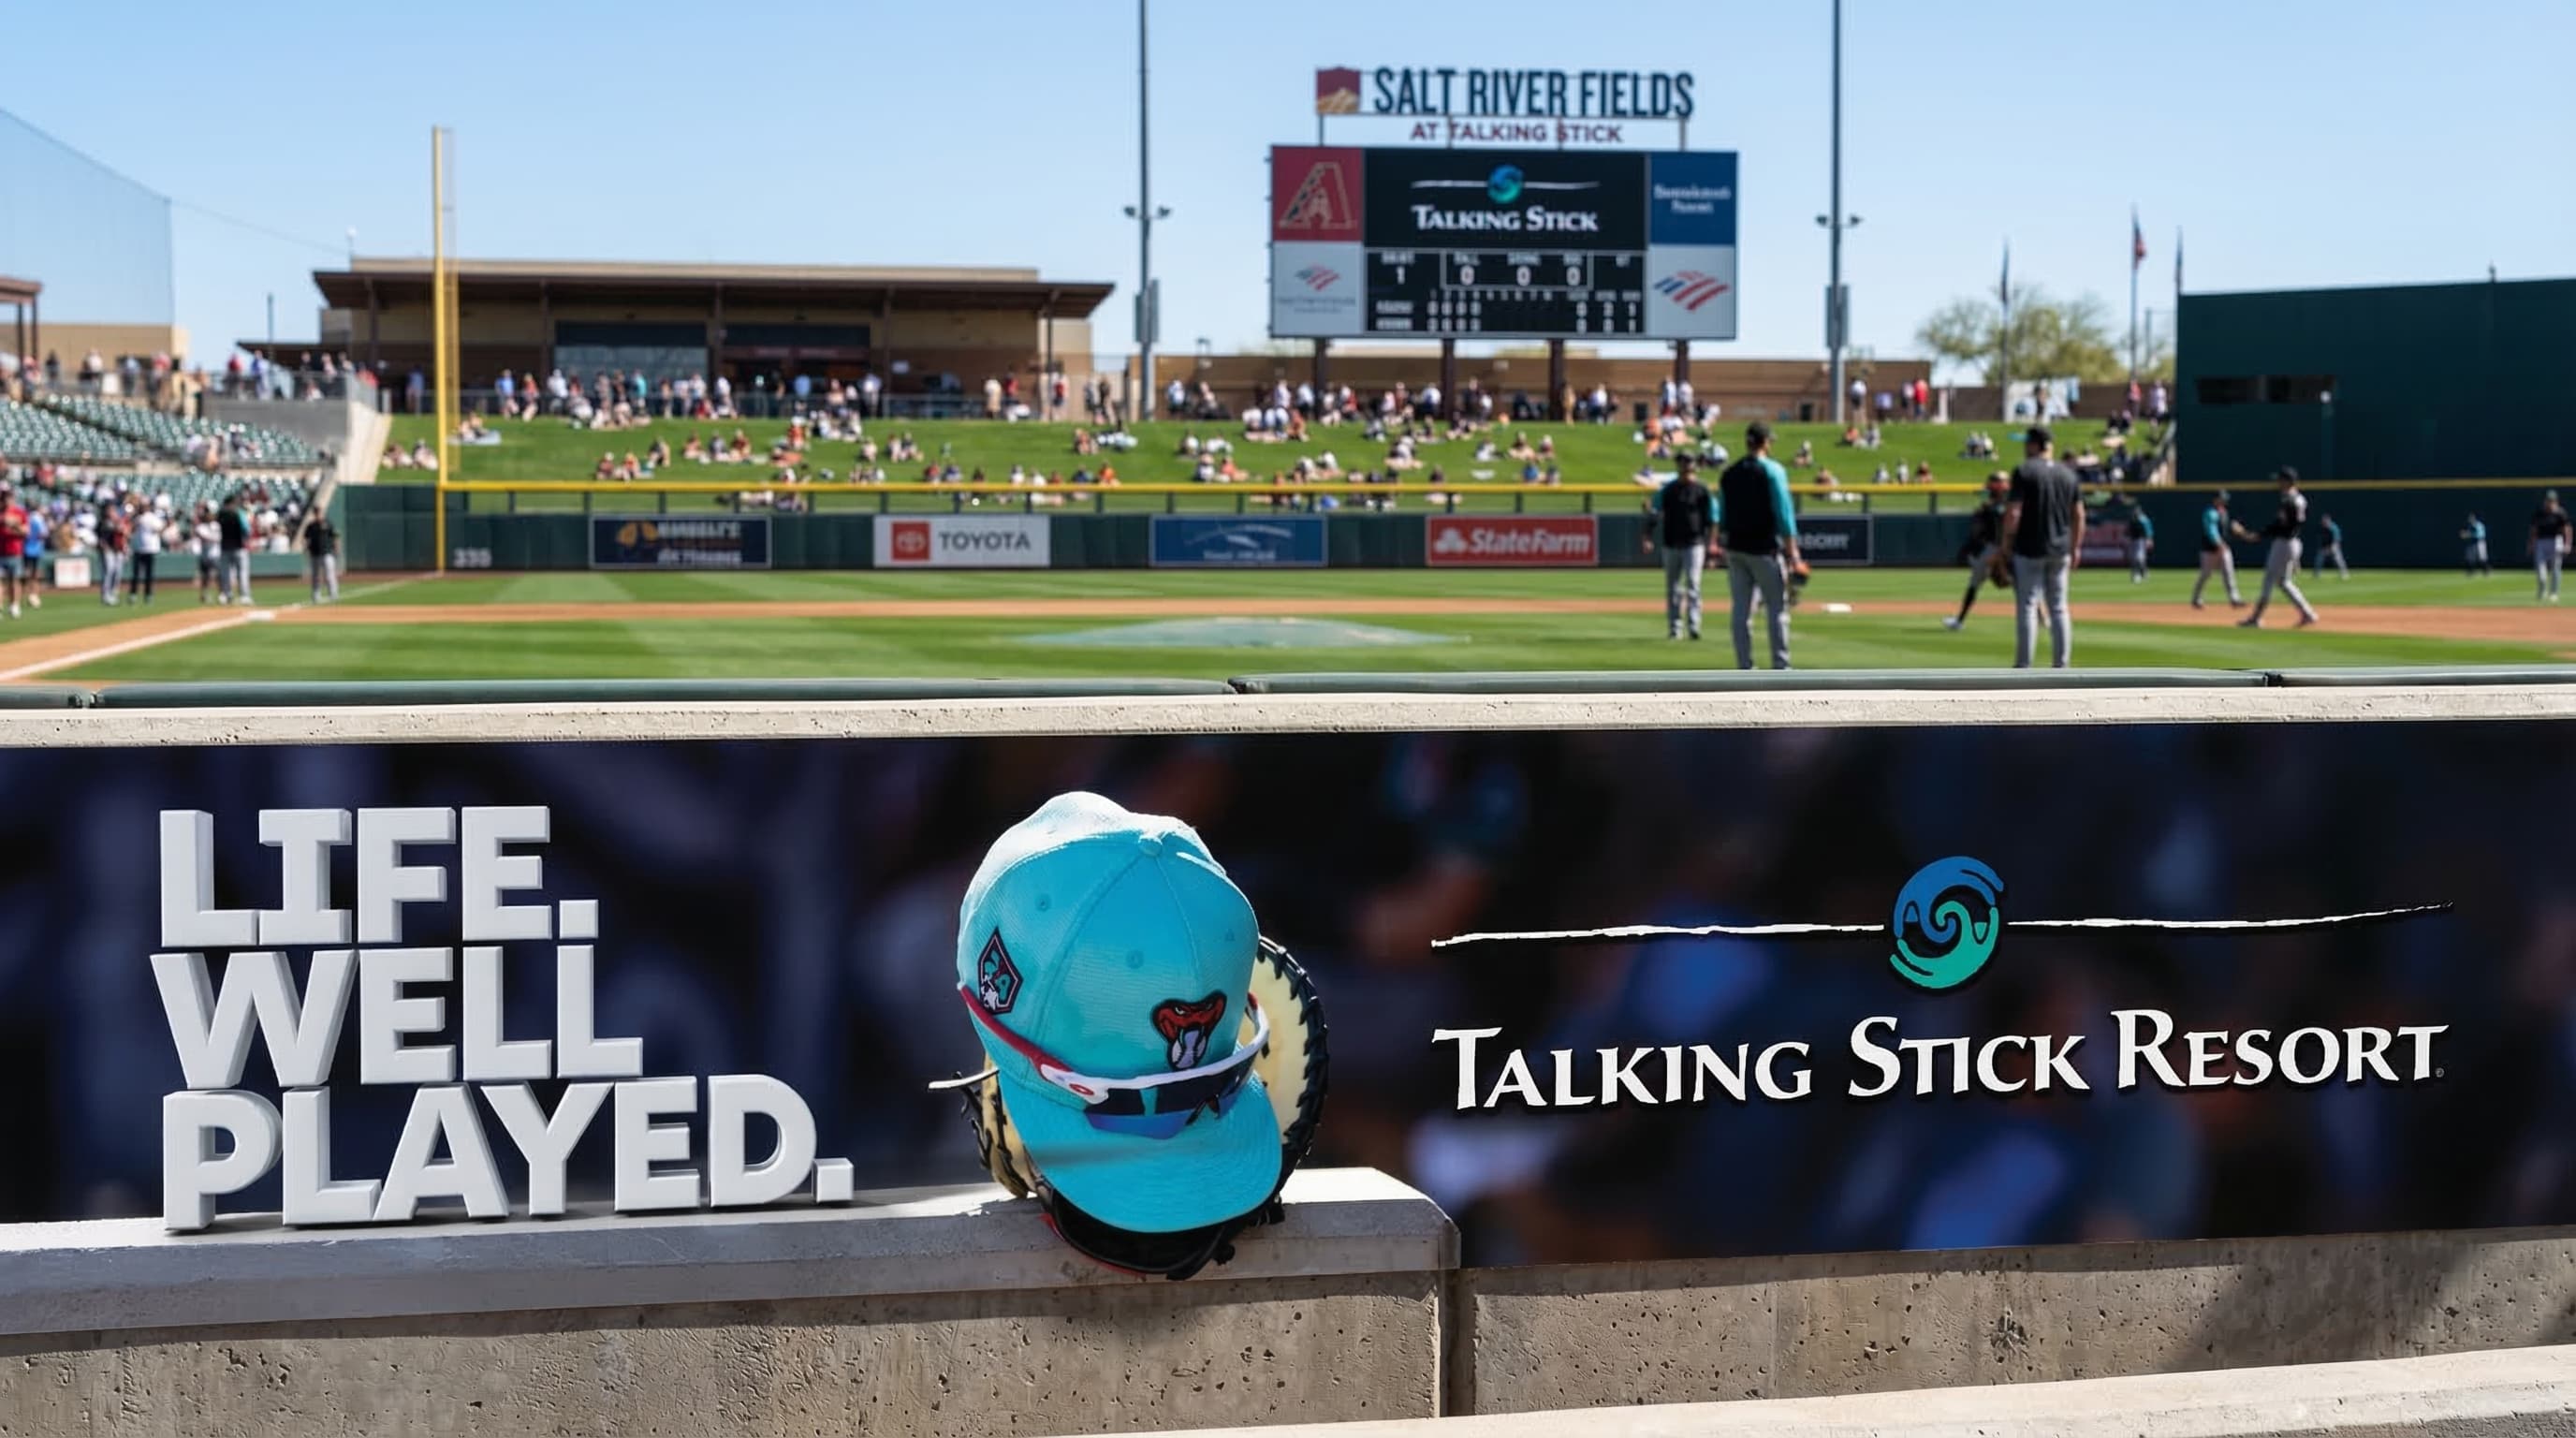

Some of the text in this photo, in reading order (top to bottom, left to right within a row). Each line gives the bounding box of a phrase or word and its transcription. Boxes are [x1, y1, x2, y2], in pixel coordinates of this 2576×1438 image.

[1373, 66, 1695, 119] SALT RIVER FIELDS
[1410, 122, 1624, 143] AT TALKING STICK
[1410, 204, 1600, 232] TALKING STICK
[938, 531, 1031, 551] TOYOTA
[159, 804, 600, 948] LIFE.
[150, 943, 644, 1089] WELL
[1430, 1008, 2450, 1111] TALKING STICK RESORT
[163, 1074, 856, 1231] PLAYED.
